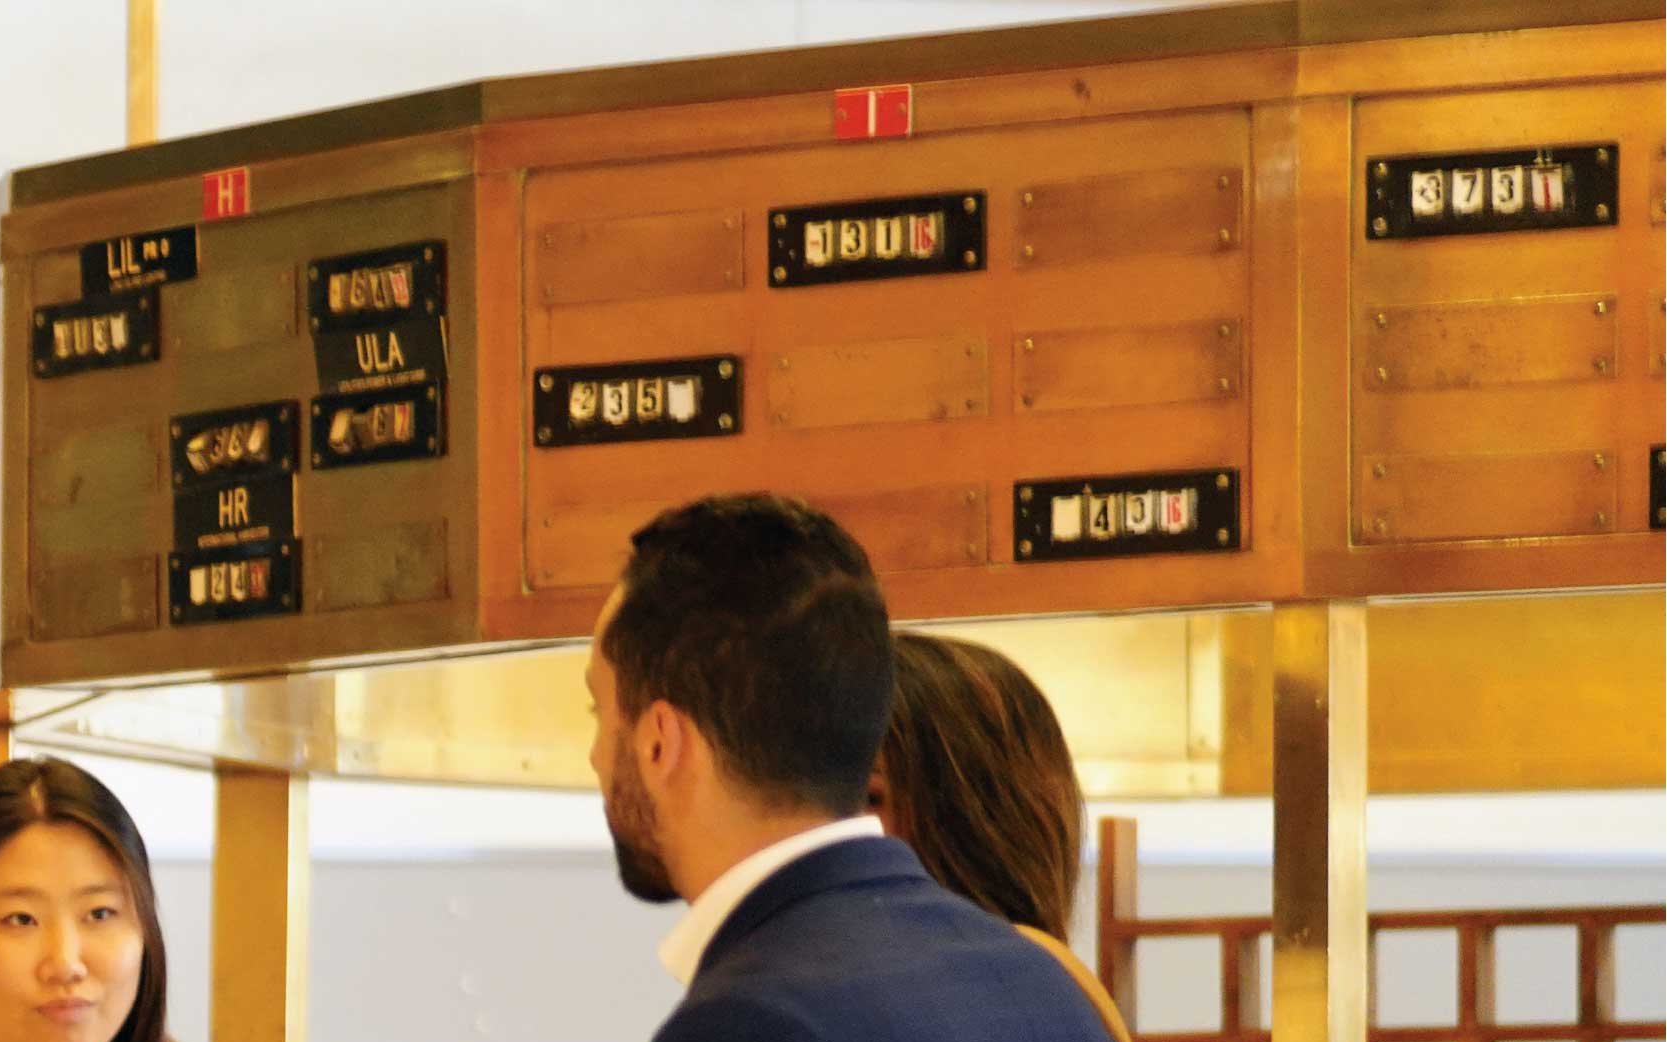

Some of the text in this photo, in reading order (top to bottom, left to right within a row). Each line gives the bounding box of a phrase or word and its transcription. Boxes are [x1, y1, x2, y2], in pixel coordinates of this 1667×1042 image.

[217, 172, 235, 218] H
[107, 237, 141, 279] LIL
[355, 331, 405, 373] ULA
[218, 486, 249, 529] HR
